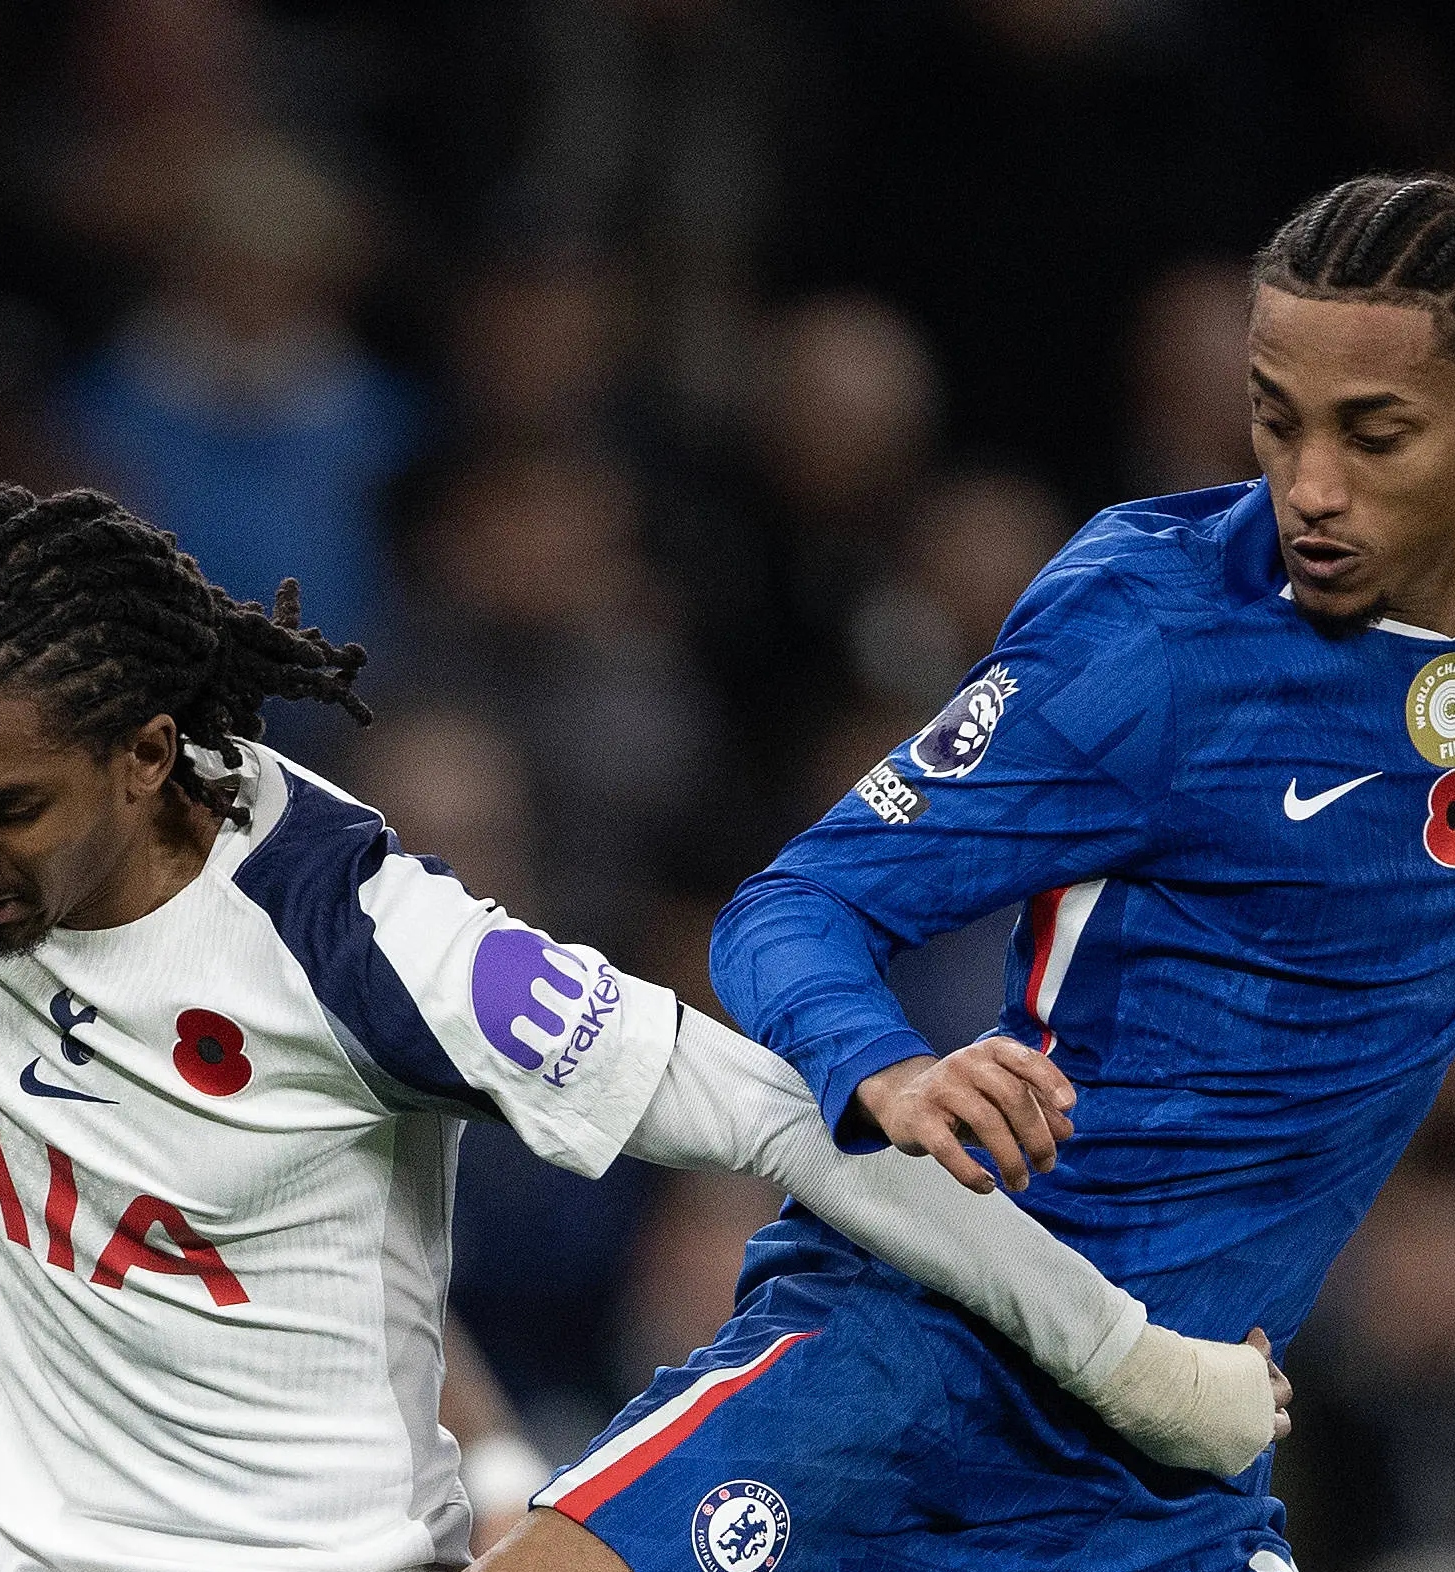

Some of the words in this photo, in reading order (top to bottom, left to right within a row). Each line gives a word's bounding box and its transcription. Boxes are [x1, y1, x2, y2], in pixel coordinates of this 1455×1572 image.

[1415, 675, 1436, 730] WORLD
[542, 964, 620, 1088] kraken
[745, 1484, 787, 1542] CHELSEA
